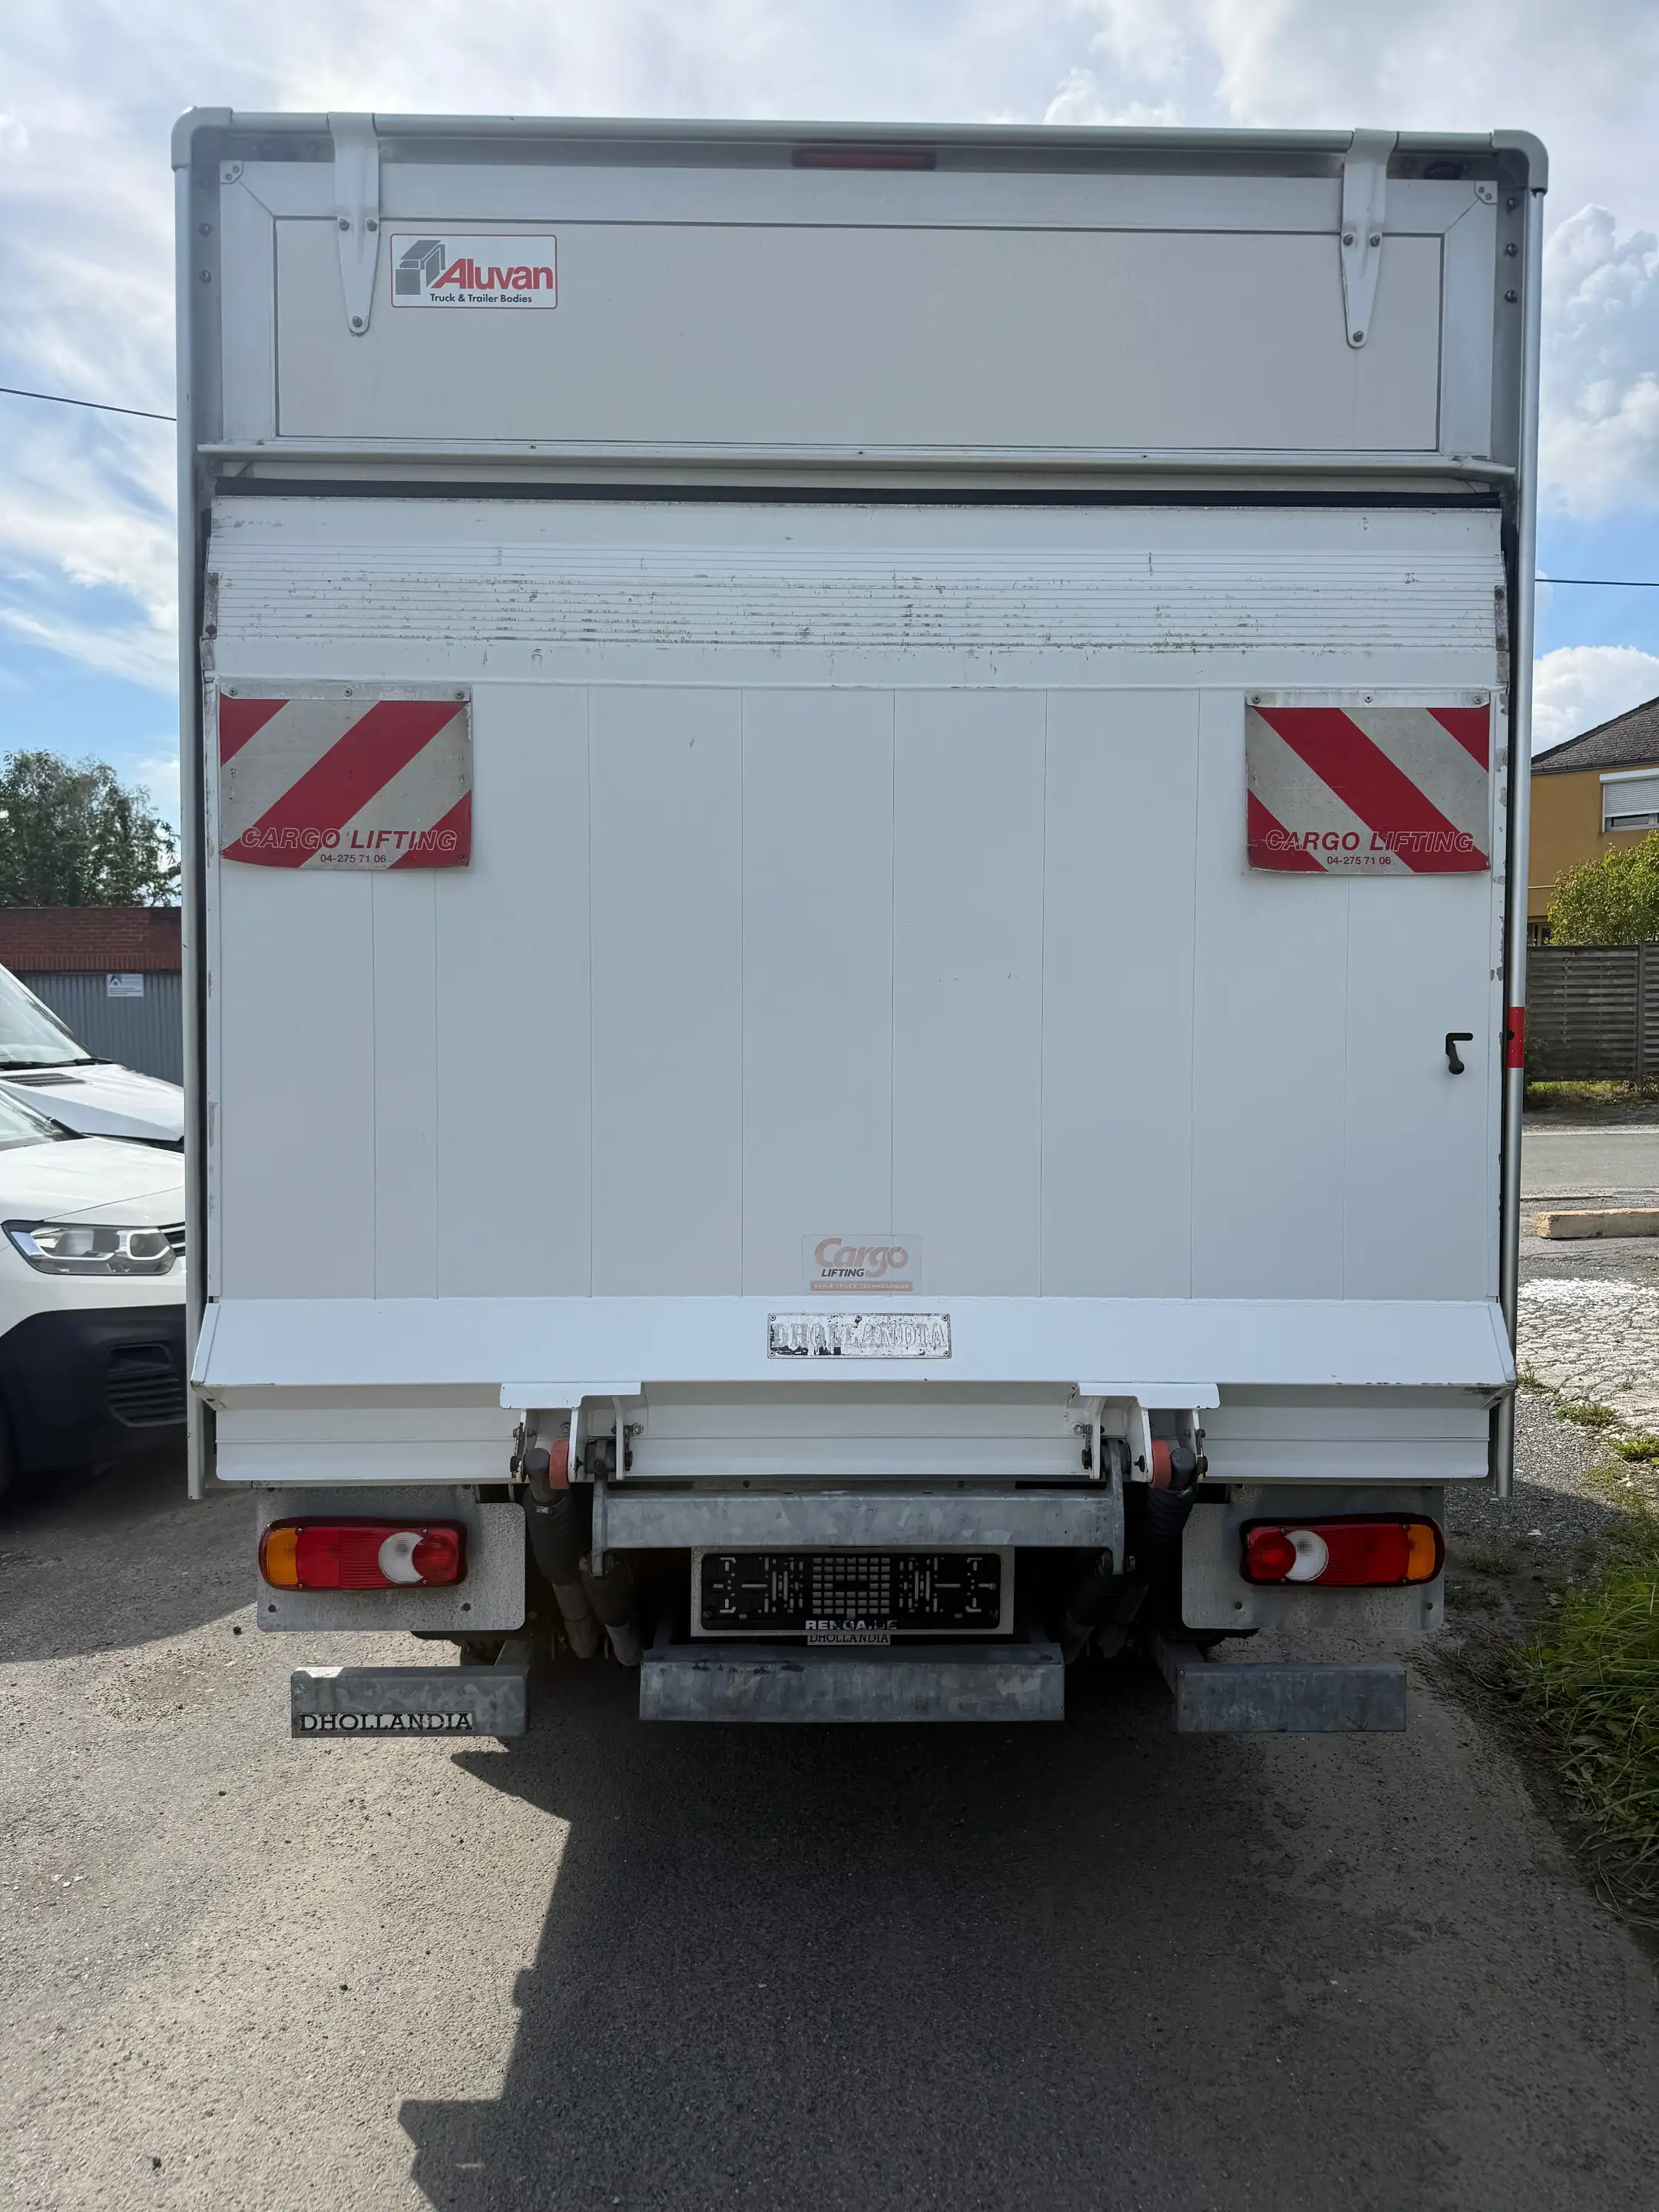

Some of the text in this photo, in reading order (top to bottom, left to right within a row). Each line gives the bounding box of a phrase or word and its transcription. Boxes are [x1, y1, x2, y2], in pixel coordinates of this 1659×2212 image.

[431, 258, 553, 290] Aluvan
[430, 293, 532, 303] Truck & Trailer Bodies
[240, 827, 458, 851] CARGO LIFTING
[1265, 830, 1475, 853] CARGO LIFTING
[320, 853, 387, 863] 04-275 71 06
[1326, 856, 1392, 866] 04-275 71 06
[814, 1237, 909, 1278] Cargo
[820, 1268, 866, 1278] LIFTING
[771, 1322, 948, 1348] DHOLLANDIA
[809, 1634, 889, 1643] DHOLLANDIA
[299, 1713, 473, 1731] DHOLLANDIA
